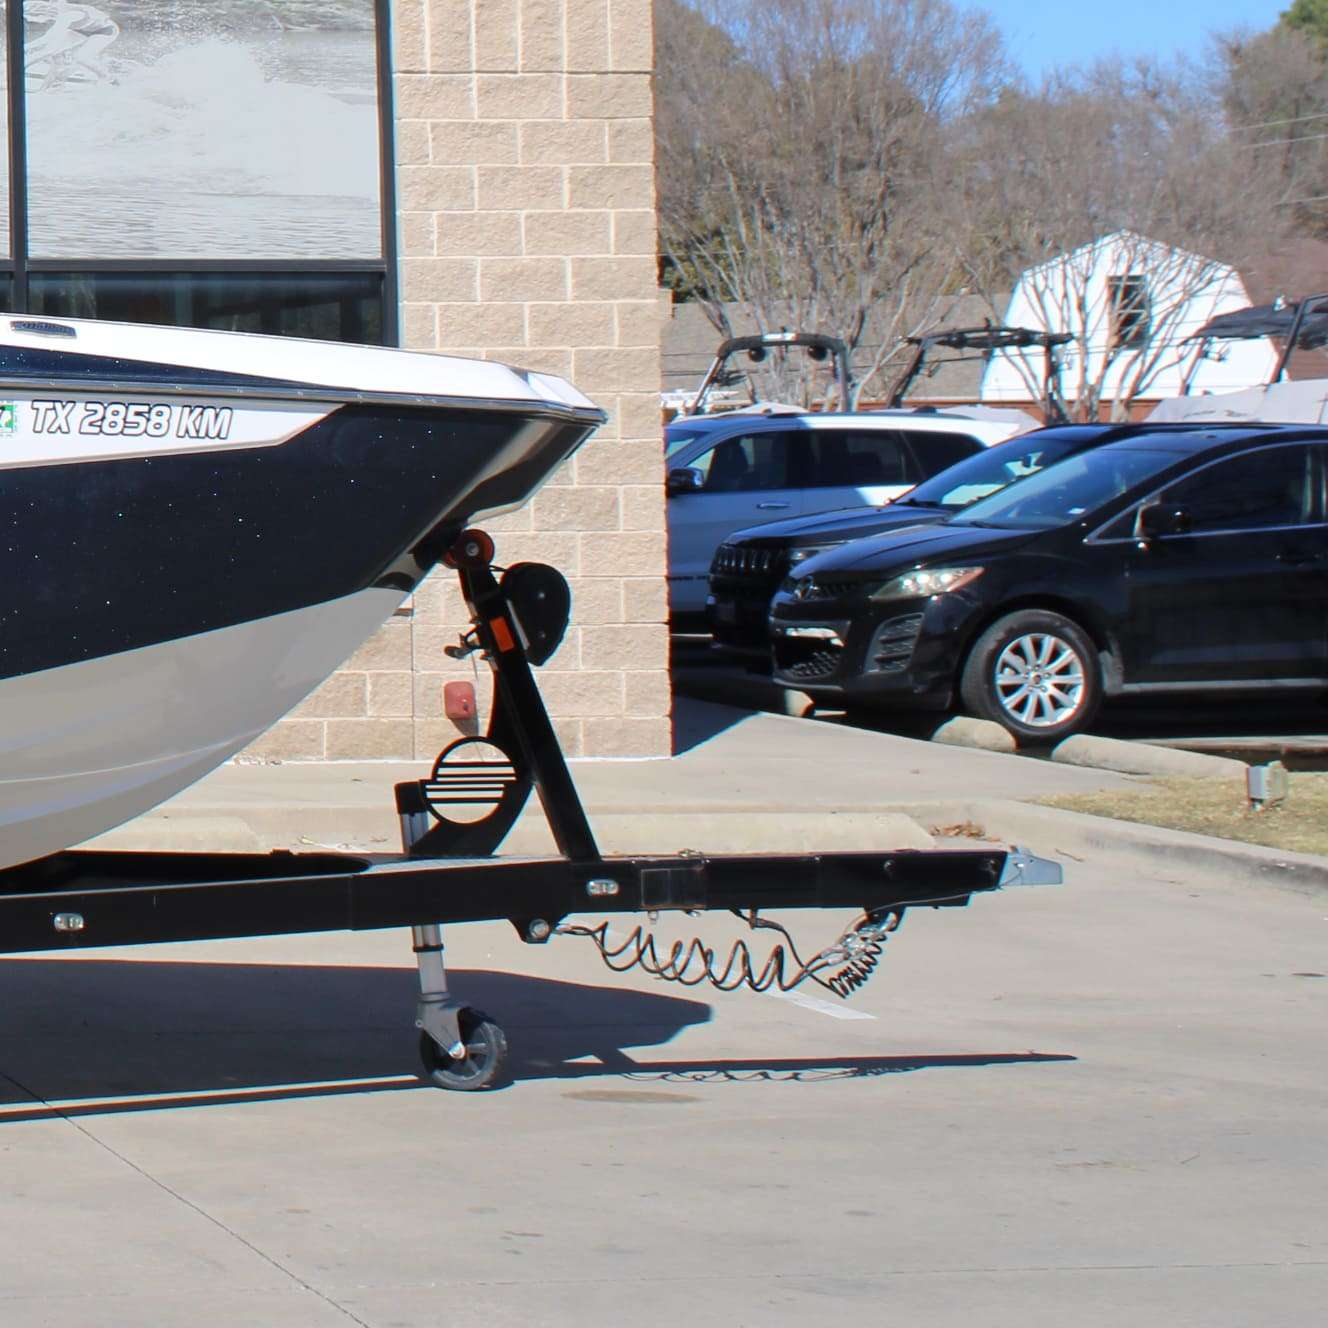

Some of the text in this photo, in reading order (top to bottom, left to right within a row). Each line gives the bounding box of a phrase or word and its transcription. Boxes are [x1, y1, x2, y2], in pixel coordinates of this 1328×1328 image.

[32, 400, 233, 439] TX 2858 KM
